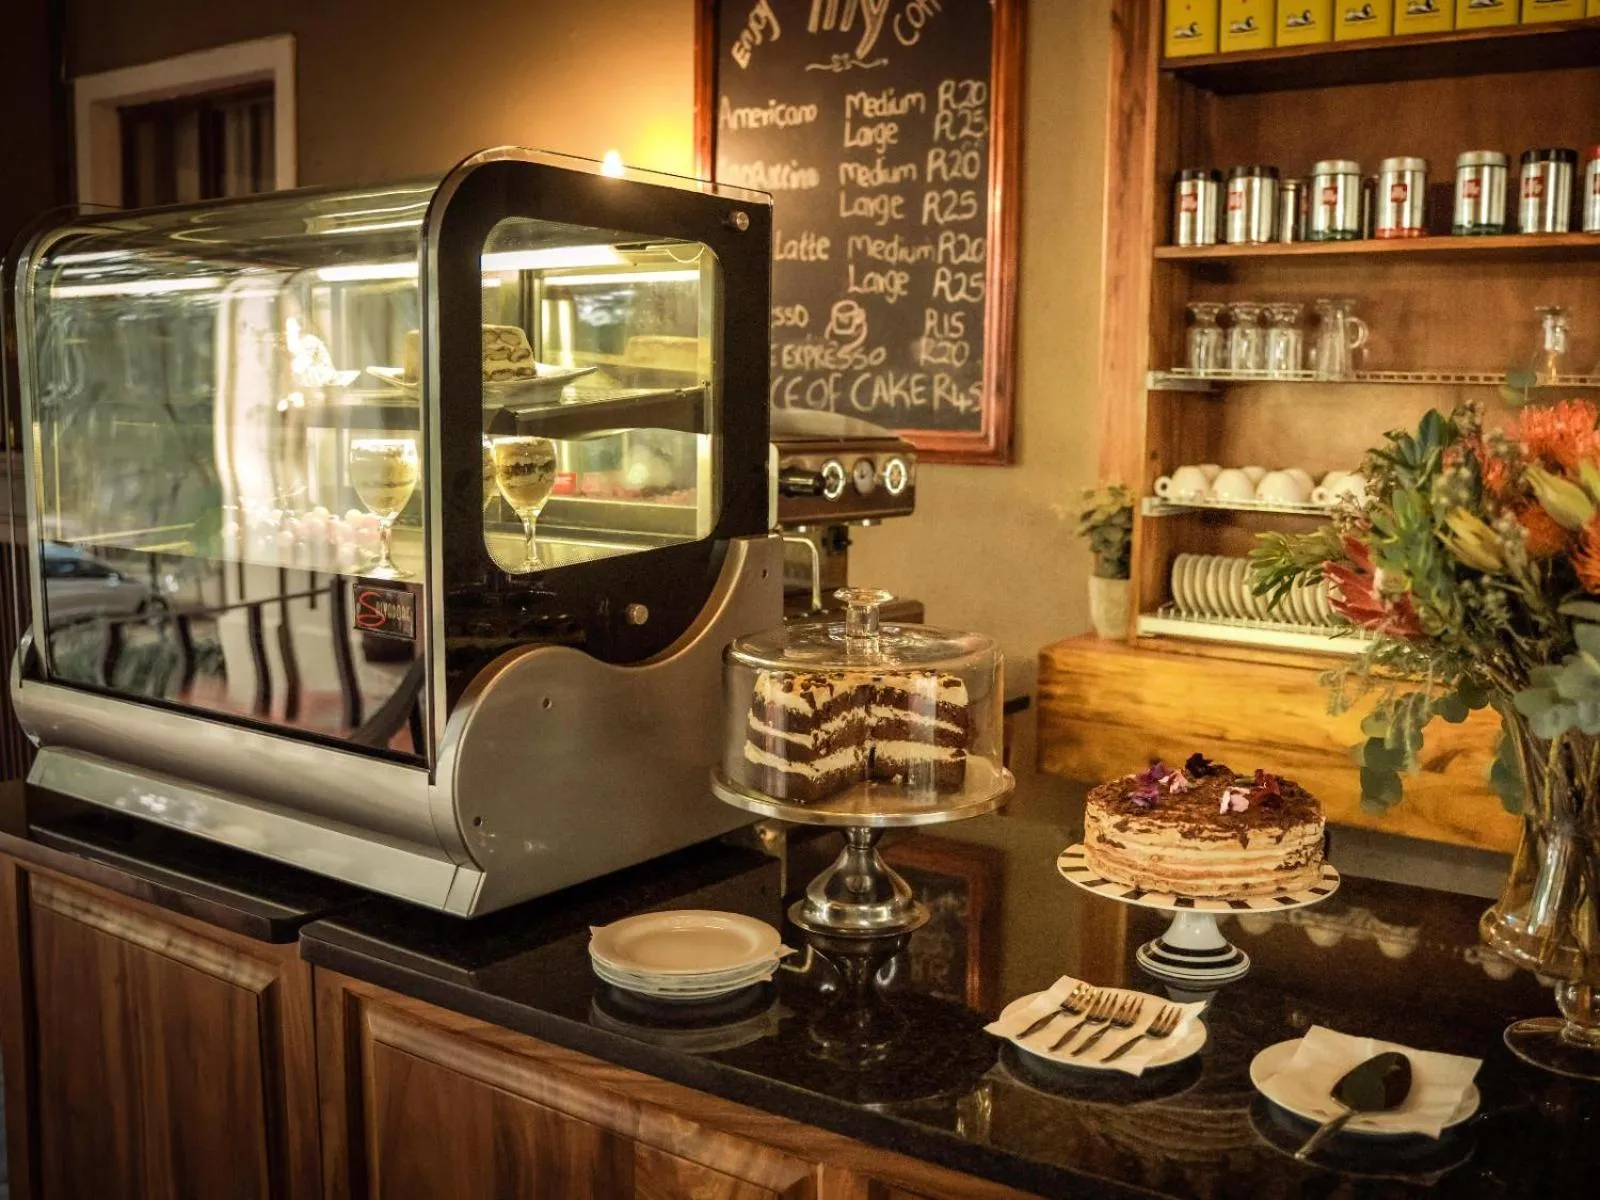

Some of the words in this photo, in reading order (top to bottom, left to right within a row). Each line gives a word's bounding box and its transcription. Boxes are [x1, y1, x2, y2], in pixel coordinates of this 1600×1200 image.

[718, 95, 818, 129] Americano
[937, 79, 987, 111] R20
[843, 122, 899, 154] Large
[933, 108, 989, 142] R25
[926, 149, 980, 184] R20
[839, 193, 905, 227] Large
[922, 189, 978, 226] R25
[773, 229, 832, 262] Latte
[937, 230, 985, 266] R20
[848, 264, 911, 304] Large
[932, 267, 985, 303] R25
[919, 340, 970, 368] R20
[806, 371, 842, 412] OF
[850, 369, 927, 412] CAKE
